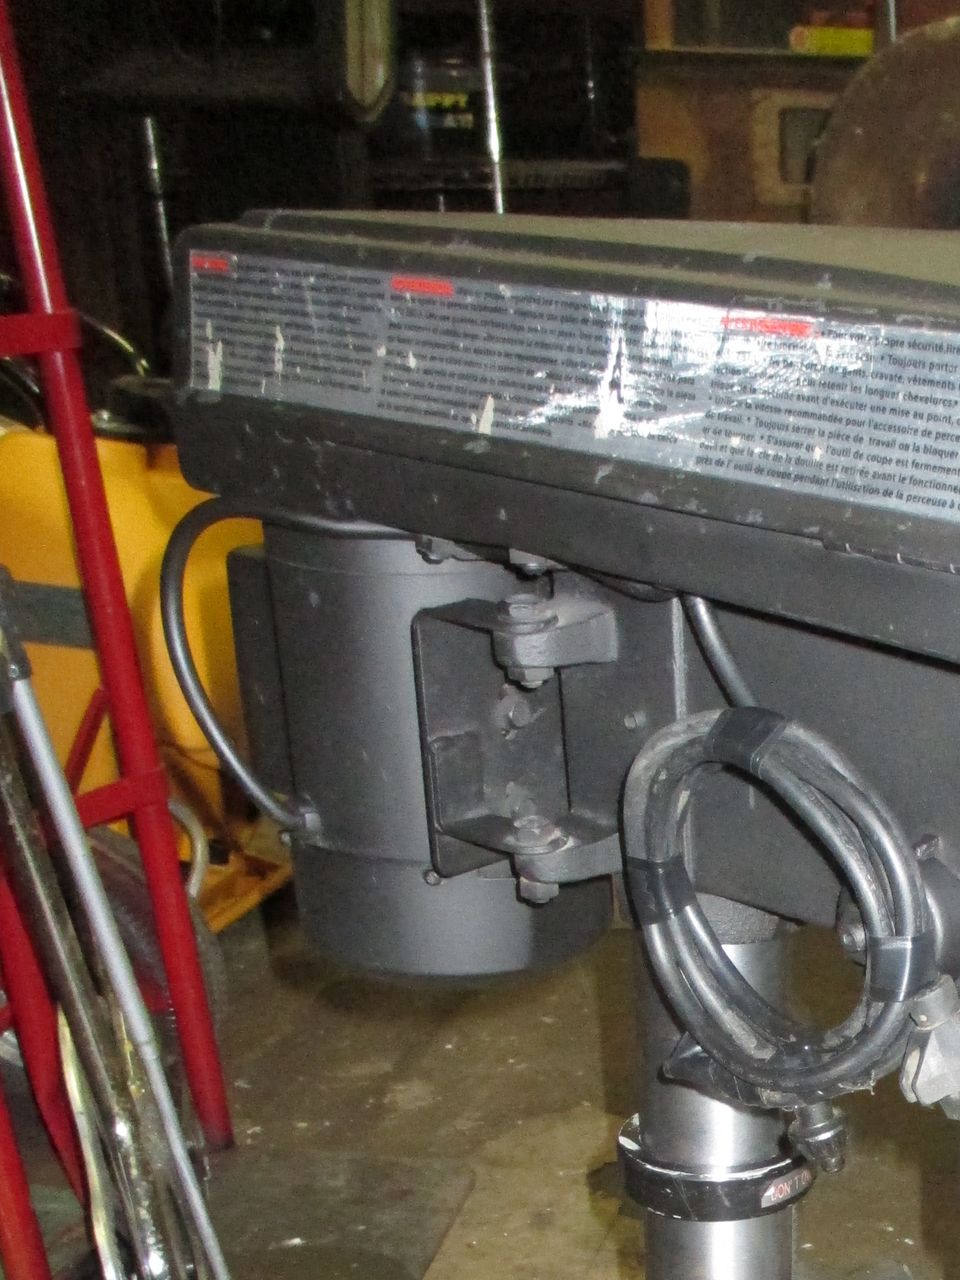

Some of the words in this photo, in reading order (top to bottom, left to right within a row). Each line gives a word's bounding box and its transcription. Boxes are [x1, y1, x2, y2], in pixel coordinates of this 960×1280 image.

[888, 354, 926, 370] Toujours
[907, 374, 955, 390] vêtements
[754, 401, 781, 415] vitesse
[784, 406, 843, 423] recommandée
[845, 418, 865, 430] pour
[867, 419, 918, 436] l'accessoire
[920, 427, 932, 438] de
[822, 396, 866, 412] d'exécuter
[870, 405, 886, 415] une
[888, 406, 910, 418] mise
[912, 410, 924, 420] au
[926, 411, 954, 426] point,
[755, 417, 789, 433] Toujours
[791, 423, 815, 435] serrer
[817, 426, 825, 436] la
[827, 428, 851, 442] pièce
[852, 433, 863, 443] de
[868, 435, 896, 449] travail
[898, 441, 909, 450] ou
[911, 442, 920, 453] la
[922, 444, 959, 461] bloquer
[767, 435, 803, 449] S'assurer
[805, 442, 820, 453] qu
[825, 444, 851, 457] l'outil
[852, 448, 863, 460] de
[866, 453, 892, 466] coupe
[895, 456, 908, 467] est
[911, 459, 960, 476] fermement
[714, 456, 725, 467] de
[754, 464, 764, 475] de
[766, 468, 791, 481] coupe
[792, 471, 829, 488] pendant
[881, 486, 893, 497] de
[895, 487, 903, 499] la
[905, 491, 947, 508] perceuse
[772, 452, 782, 463] de
[785, 454, 792, 464] la
[794, 454, 823, 469] douille
[825, 461, 838, 471] est
[840, 464, 869, 477] retirée
[871, 470, 896, 482] avant
[898, 473, 906, 483] le
